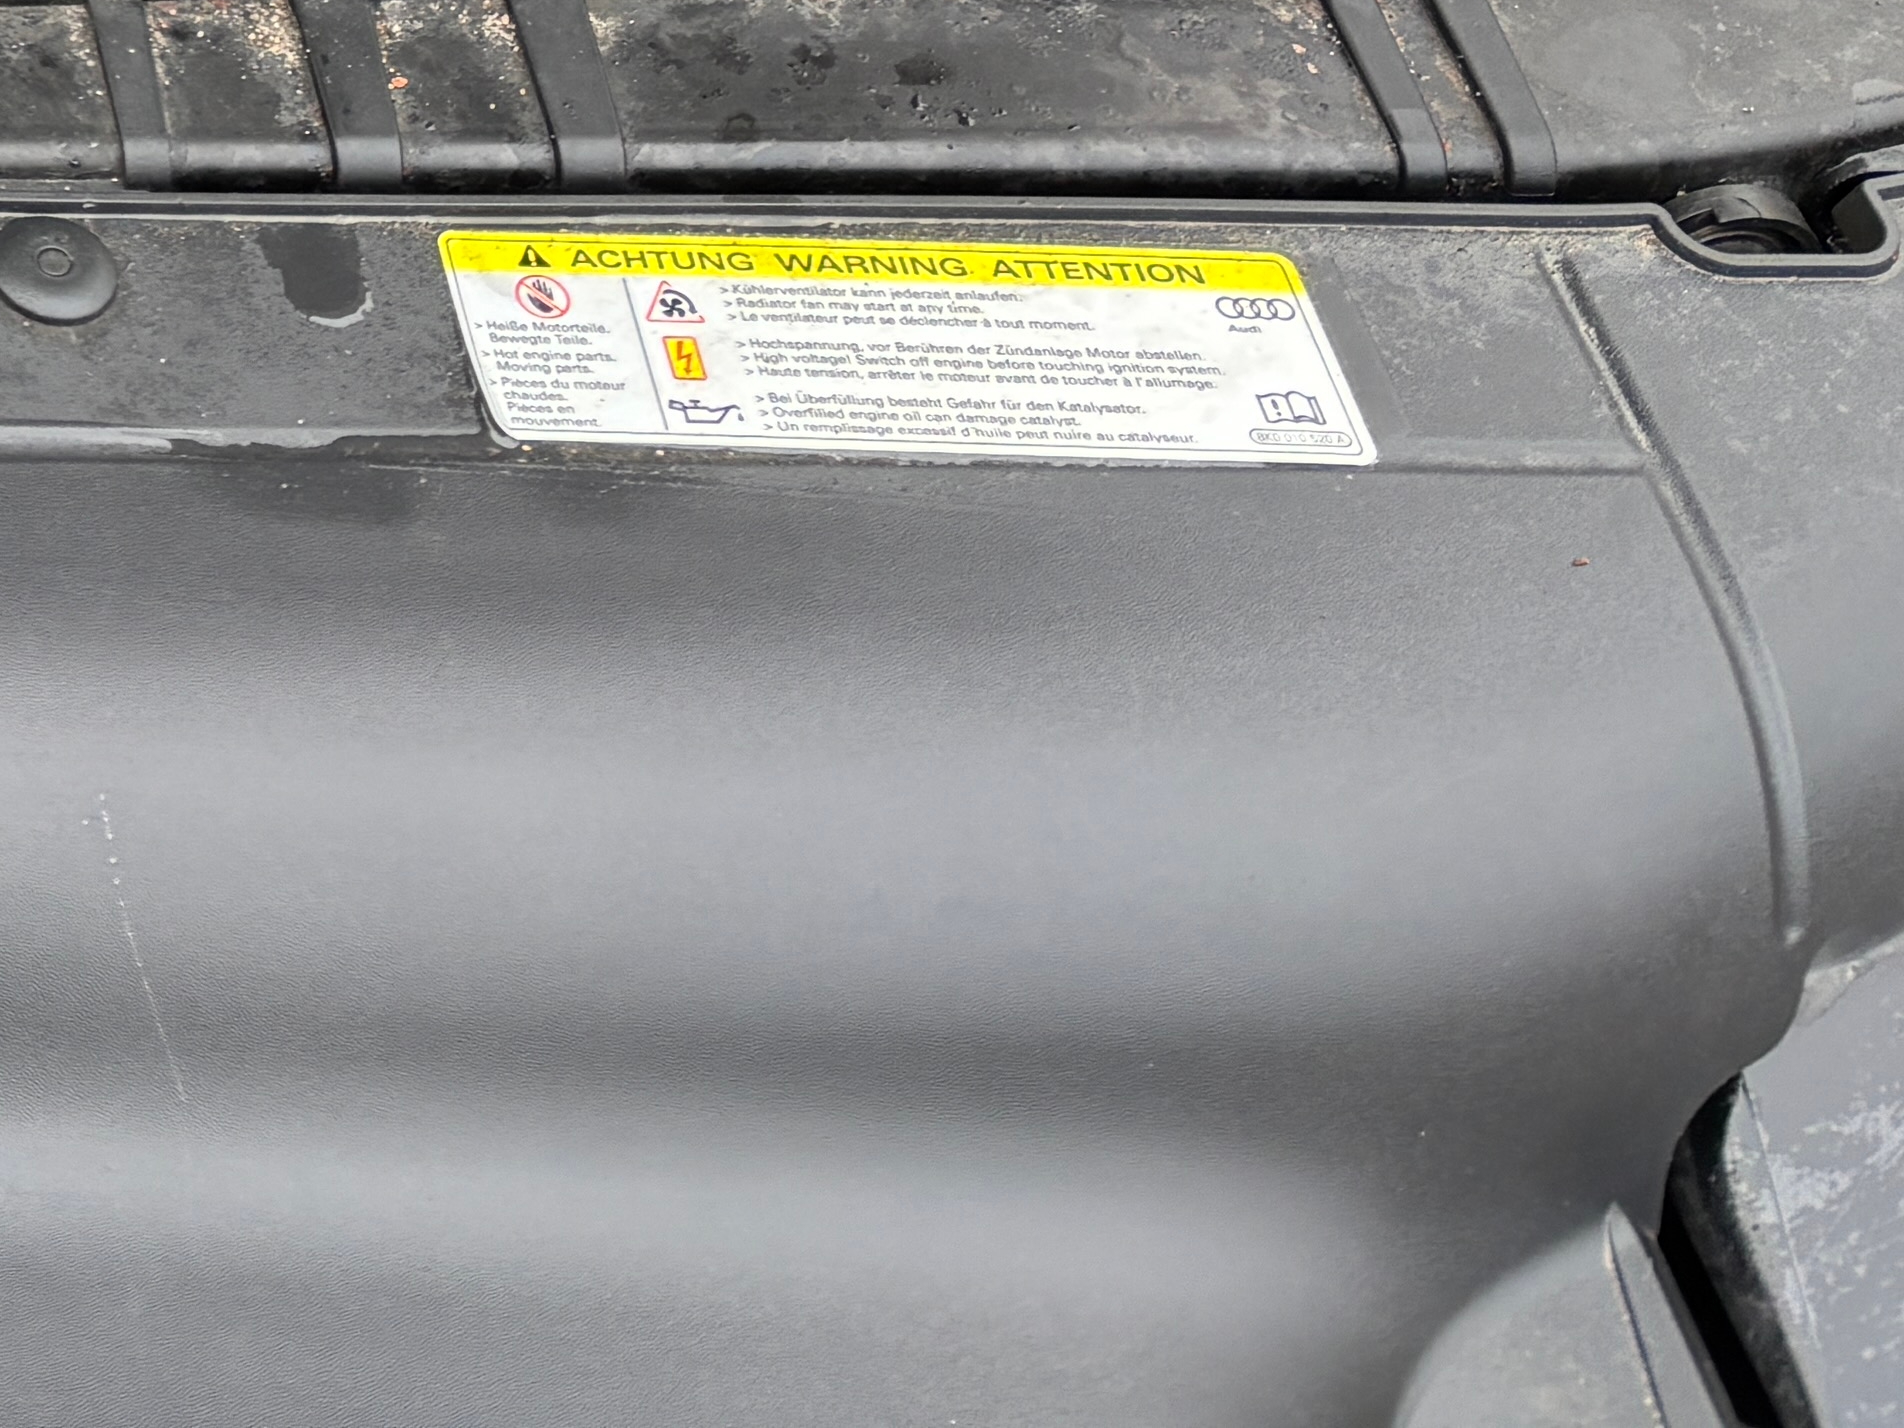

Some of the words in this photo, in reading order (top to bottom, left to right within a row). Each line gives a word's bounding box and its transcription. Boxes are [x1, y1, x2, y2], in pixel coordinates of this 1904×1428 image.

[570, 248, 754, 272] ACHTUNG
[993, 258, 1206, 285] ATTENTION
[731, 284, 847, 297] Kühlerventilator
[851, 287, 887, 299] kann
[890, 288, 951, 300] jederzeit
[735, 297, 797, 309] Radiator
[801, 299, 825, 310] fan
[829, 301, 859, 313] may
[863, 301, 896, 312] start
[900, 303, 914, 313] at
[918, 304, 943, 315] any
[947, 303, 984, 314] time.
[486, 320, 528, 332] Heiße
[532, 322, 611, 334] Motorteile.
[740, 310, 759, 322] Le
[760, 312, 839, 324] ventilateur
[843, 315, 876, 326] peut
[879, 316, 896, 326] se
[899, 315, 978, 328] déclencher
[995, 318, 1025, 330] tout
[1028, 320, 1096, 331] moment.
[1228, 324, 1263, 334] Audi
[489, 332, 551, 346] Bewegte
[554, 334, 593, 345] Teile.
[494, 349, 518, 359] Hot
[523, 350, 572, 362] engine
[576, 352, 617, 363] parts.
[749, 338, 864, 353] Hochspannung,
[867, 342, 891, 353] vor
[895, 341, 964, 355] Berühren
[967, 343, 991, 355] der
[993, 344, 1083, 360] Zündanlage
[1085, 347, 1130, 360] Motor
[1135, 349, 1206, 362] abstellen.
[496, 361, 552, 375] Moving
[556, 364, 595, 374] parts.
[753, 352, 788, 365] High
[791, 354, 851, 367] voltage!
[855, 353, 906, 367] Switch
[909, 356, 930, 367] off
[933, 359, 984, 370] engine
[987, 358, 1036, 371] before
[1038, 361, 1105, 374] touching
[1107, 362, 1165, 375] ignition
[1167, 364, 1226, 376] system.
[758, 366, 802, 378] Haute
[804, 368, 865, 380] tension,
[868, 369, 915, 381] arrêter
[920, 371, 934, 382] le
[938, 373, 991, 383] moteur
[995, 374, 1037, 385] avant
[1041, 375, 1059, 386] de
[1062, 375, 1118, 387] toucher
[550, 379, 570, 390] du
[574, 380, 626, 391] moteur
[504, 390, 569, 401] chaudes.
[767, 392, 792, 404] Bei
[795, 390, 885, 409] Überfüllung
[887, 395, 943, 409] besteht
[947, 397, 996, 410] Gefahr
[1000, 398, 1022, 411] für
[1026, 400, 1054, 411] den
[1057, 400, 1147, 415] Katalysator.
[557, 405, 575, 414] en
[772, 406, 846, 420] Overfilled
[849, 410, 899, 423] engine
[902, 411, 922, 422] oil
[925, 413, 952, 424] can
[956, 413, 1016, 426] damage
[1019, 415, 1082, 428] catalyst.
[776, 421, 800, 432] Un
[803, 422, 894, 437] remplissage
[897, 425, 956, 437] excessif
[1015, 430, 1049, 441] peut
[1053, 429, 1092, 441] nuire
[1096, 432, 1115, 442] au
[1118, 431, 1199, 444] catalyseur.
[1256, 432, 1281, 442] 8K0
[1283, 433, 1307, 443] 010
